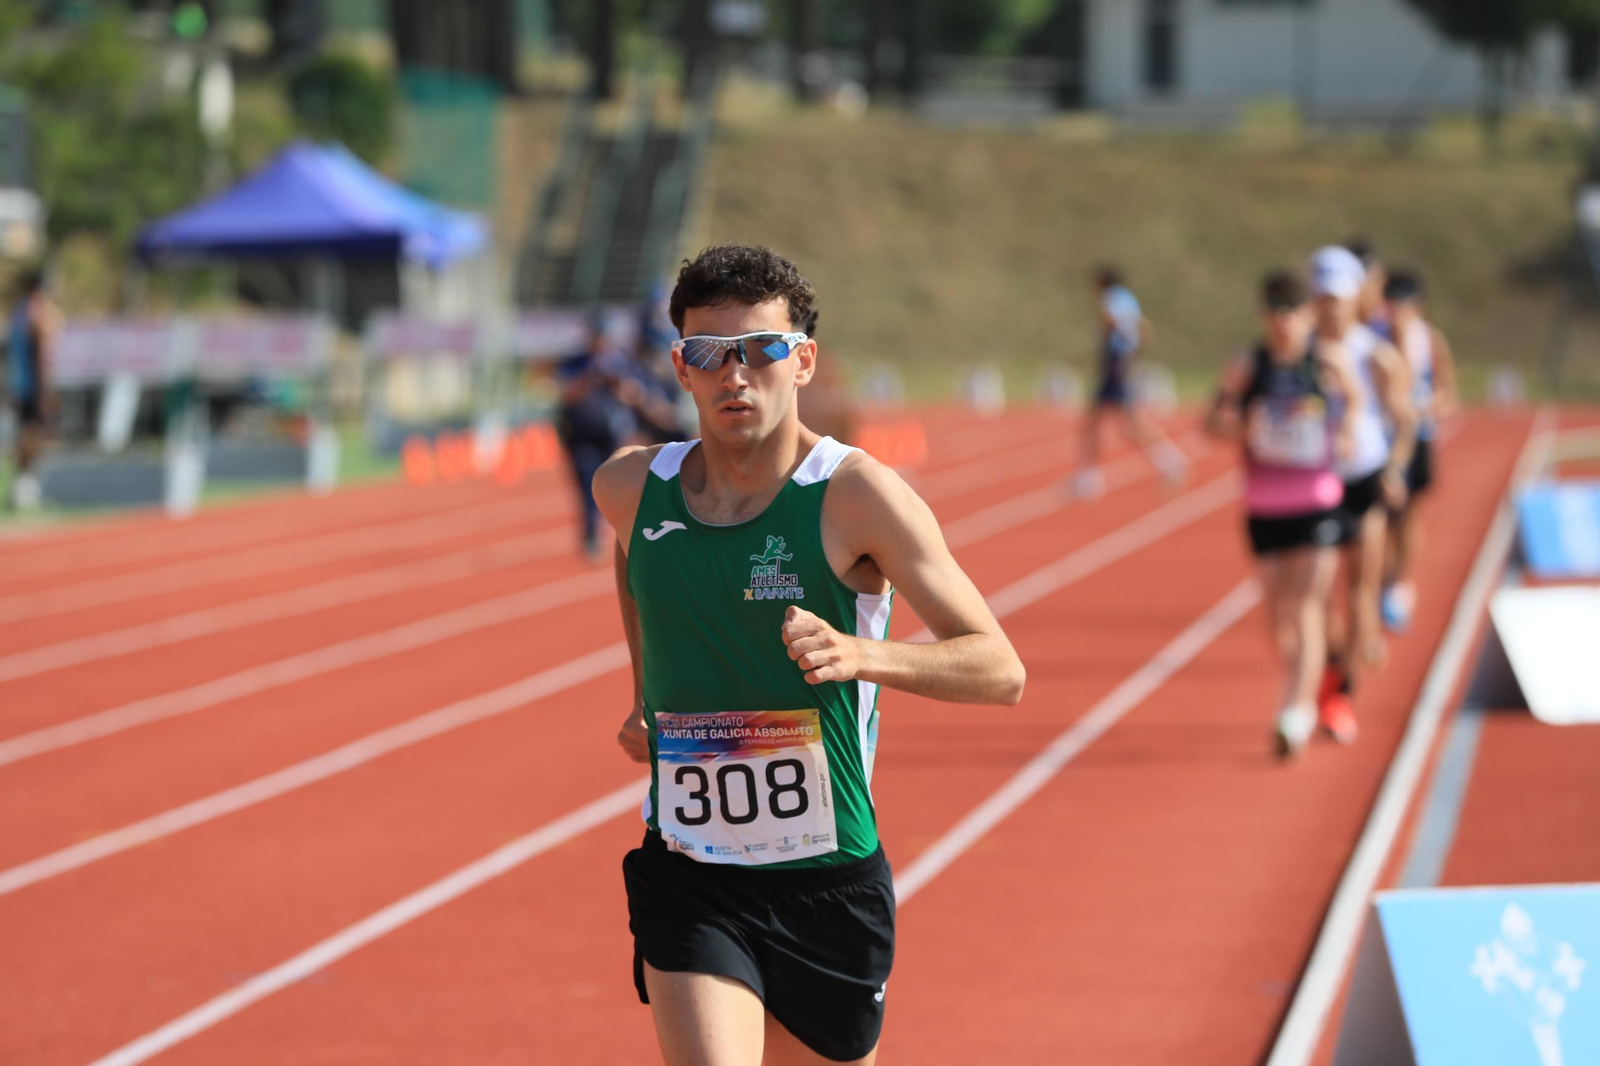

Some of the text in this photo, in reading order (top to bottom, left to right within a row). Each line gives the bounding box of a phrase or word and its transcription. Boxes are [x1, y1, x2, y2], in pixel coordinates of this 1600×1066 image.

[751, 565, 777, 576] AMES
[750, 574, 798, 587] ATLETISMO
[681, 716, 744, 728] CAMPIONATO
[663, 726, 814, 739] XUNTA DE GALICIA ABSOLUTO
[675, 758, 809, 826] 308
